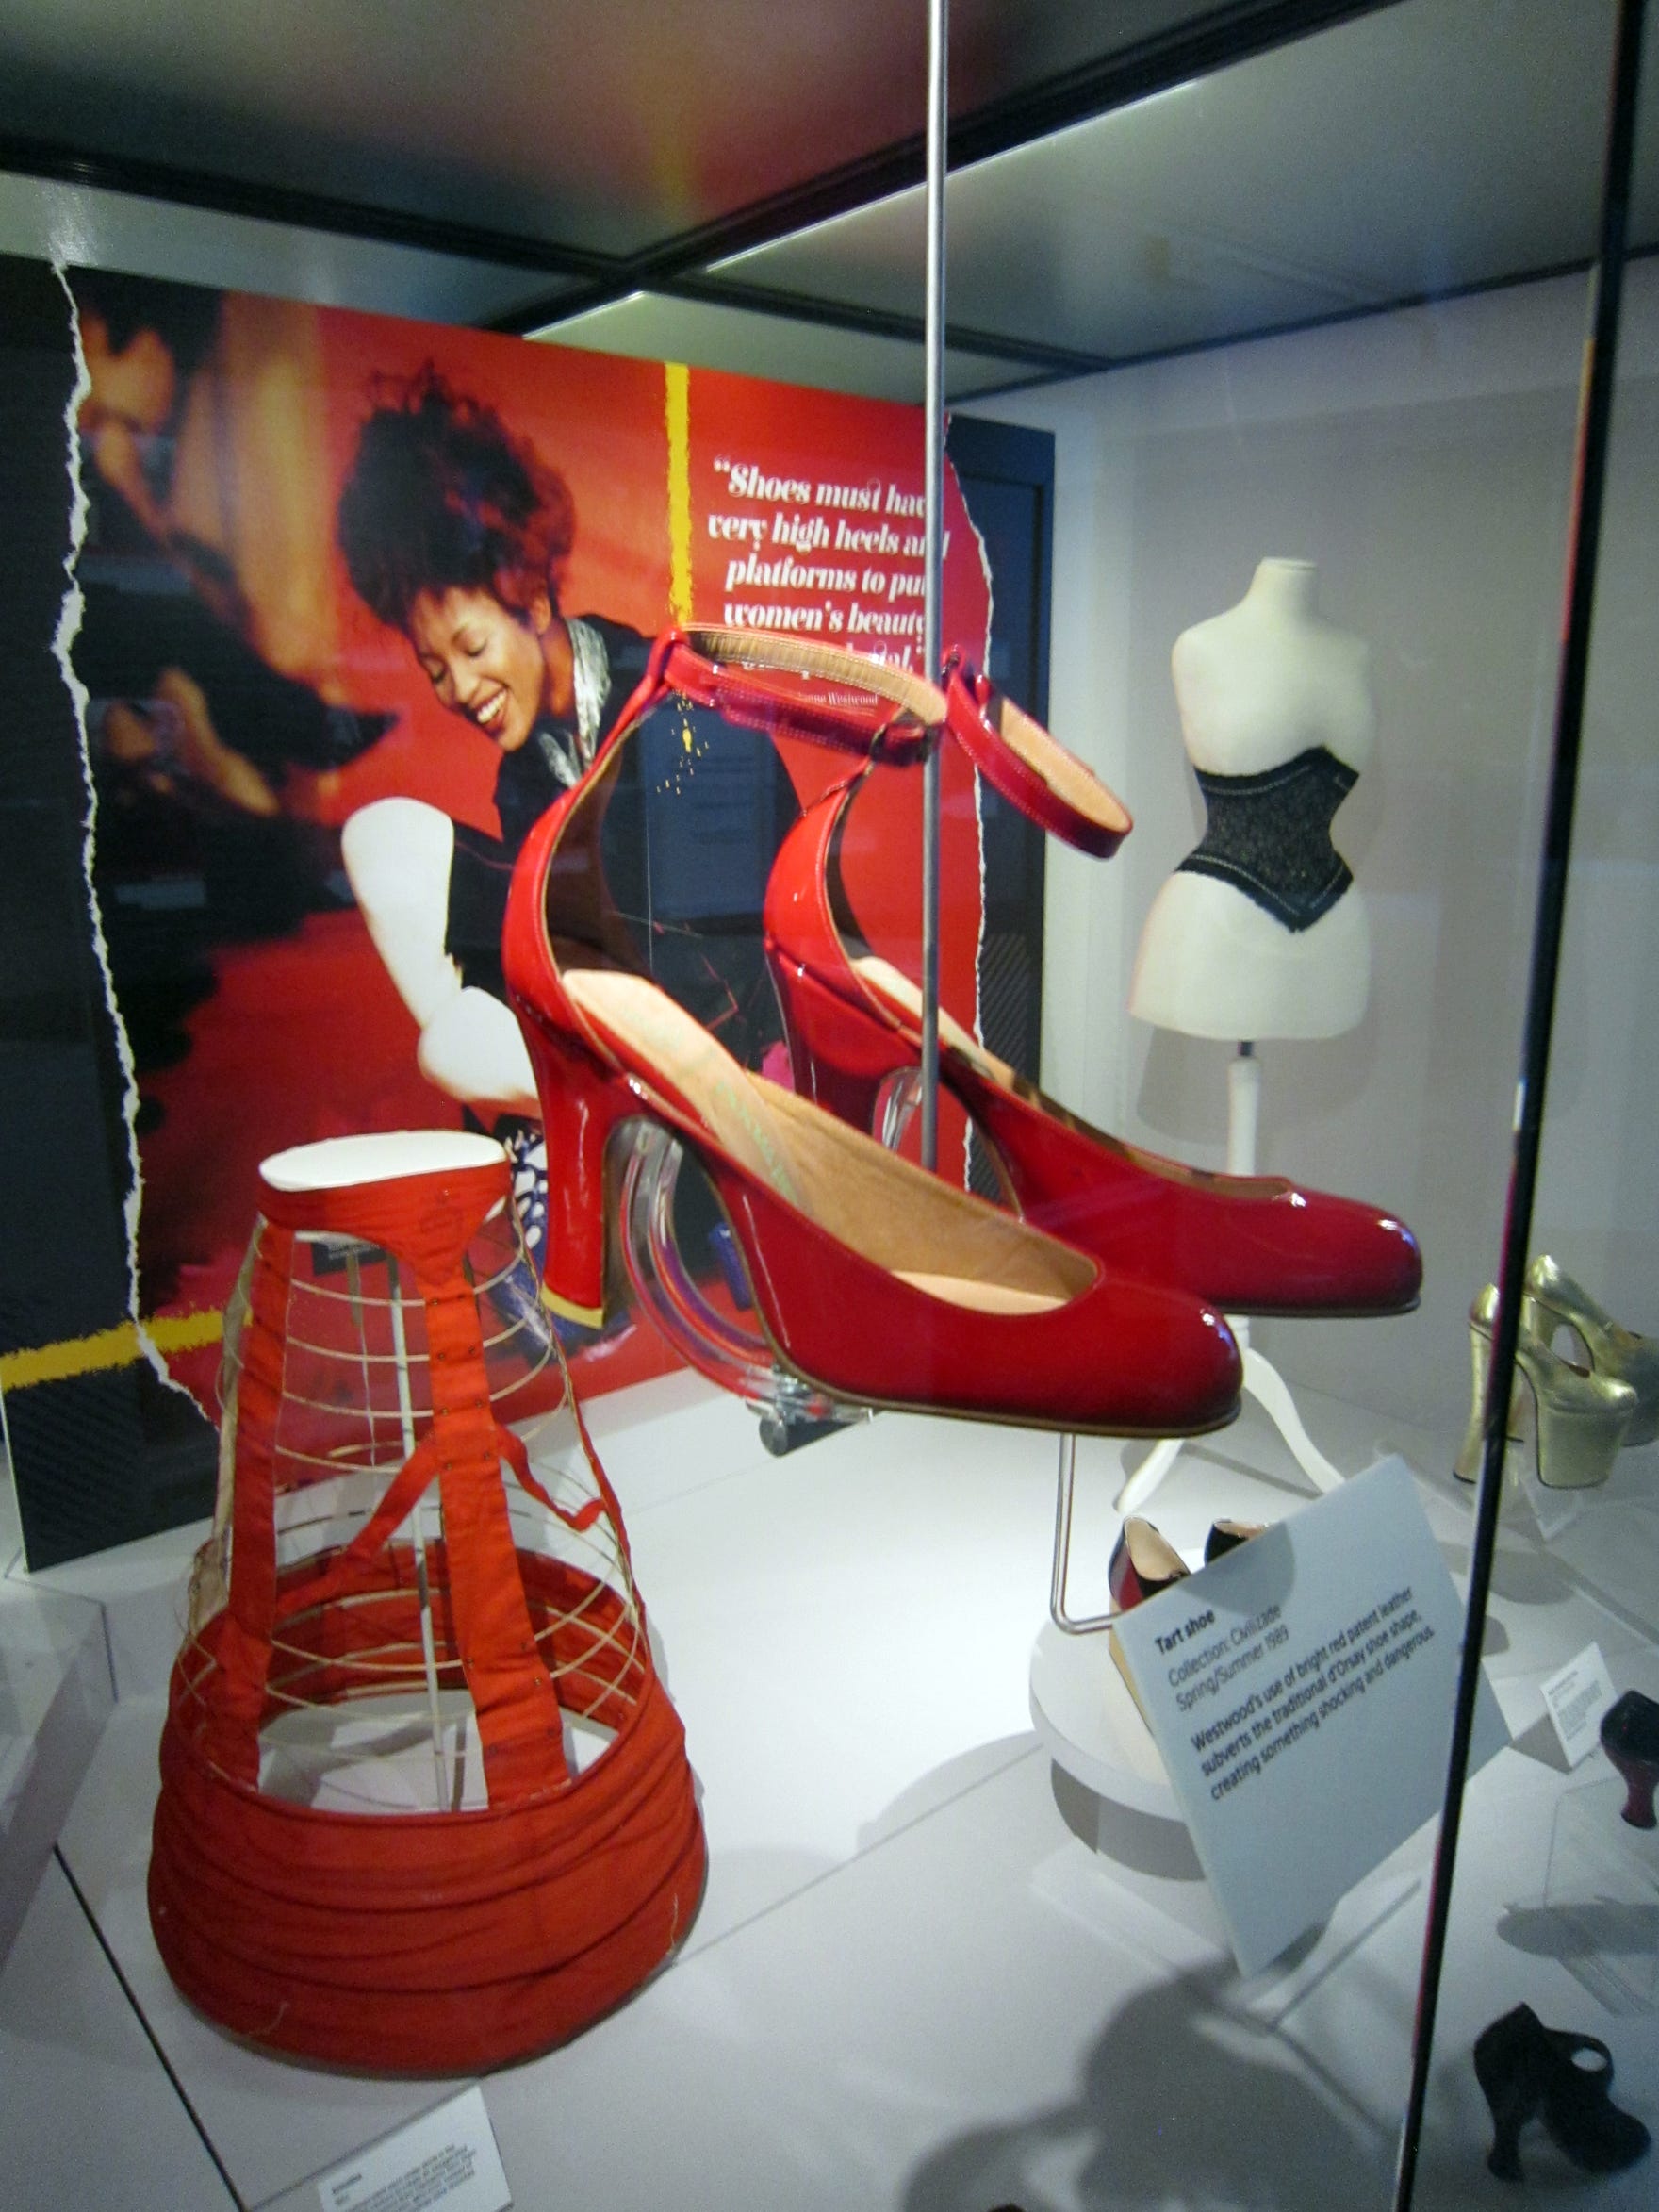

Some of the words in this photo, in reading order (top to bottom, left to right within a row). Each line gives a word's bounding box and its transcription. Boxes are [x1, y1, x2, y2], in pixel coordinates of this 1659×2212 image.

[814, 477, 882, 513] must
[707, 513, 767, 552] very
[771, 512, 830, 554] high
[835, 519, 900, 555] heels
[724, 553, 857, 593] platforms
[861, 567, 886, 594] to
[723, 600, 844, 633] women's
[1155, 1628, 1185, 1656] Tart
[1184, 1609, 1216, 1639] shoe
[1175, 1642, 1265, 1712] Spring/Summer
[1264, 1623, 1290, 1651] 1989
[1191, 1694, 1264, 1753] Westwood's
[1263, 1680, 1283, 1703] use
[1284, 1666, 1297, 1688] of
[1296, 1645, 1329, 1678] bright
[1328, 1629, 1347, 1655] red
[1347, 1609, 1380, 1643] patent
[1377, 1585, 1413, 1619] leather
[1201, 1731, 1253, 1777] subverts
[1251, 1716, 1273, 1741] the
[1272, 1674, 1328, 1725] traditional
[1365, 1630, 1389, 1656] shoe
[1210, 1754, 1262, 1801] creating
[1260, 1710, 1321, 1763] something
[1318, 1676, 1366, 1719] shocking
[1364, 1659, 1384, 1685] and
